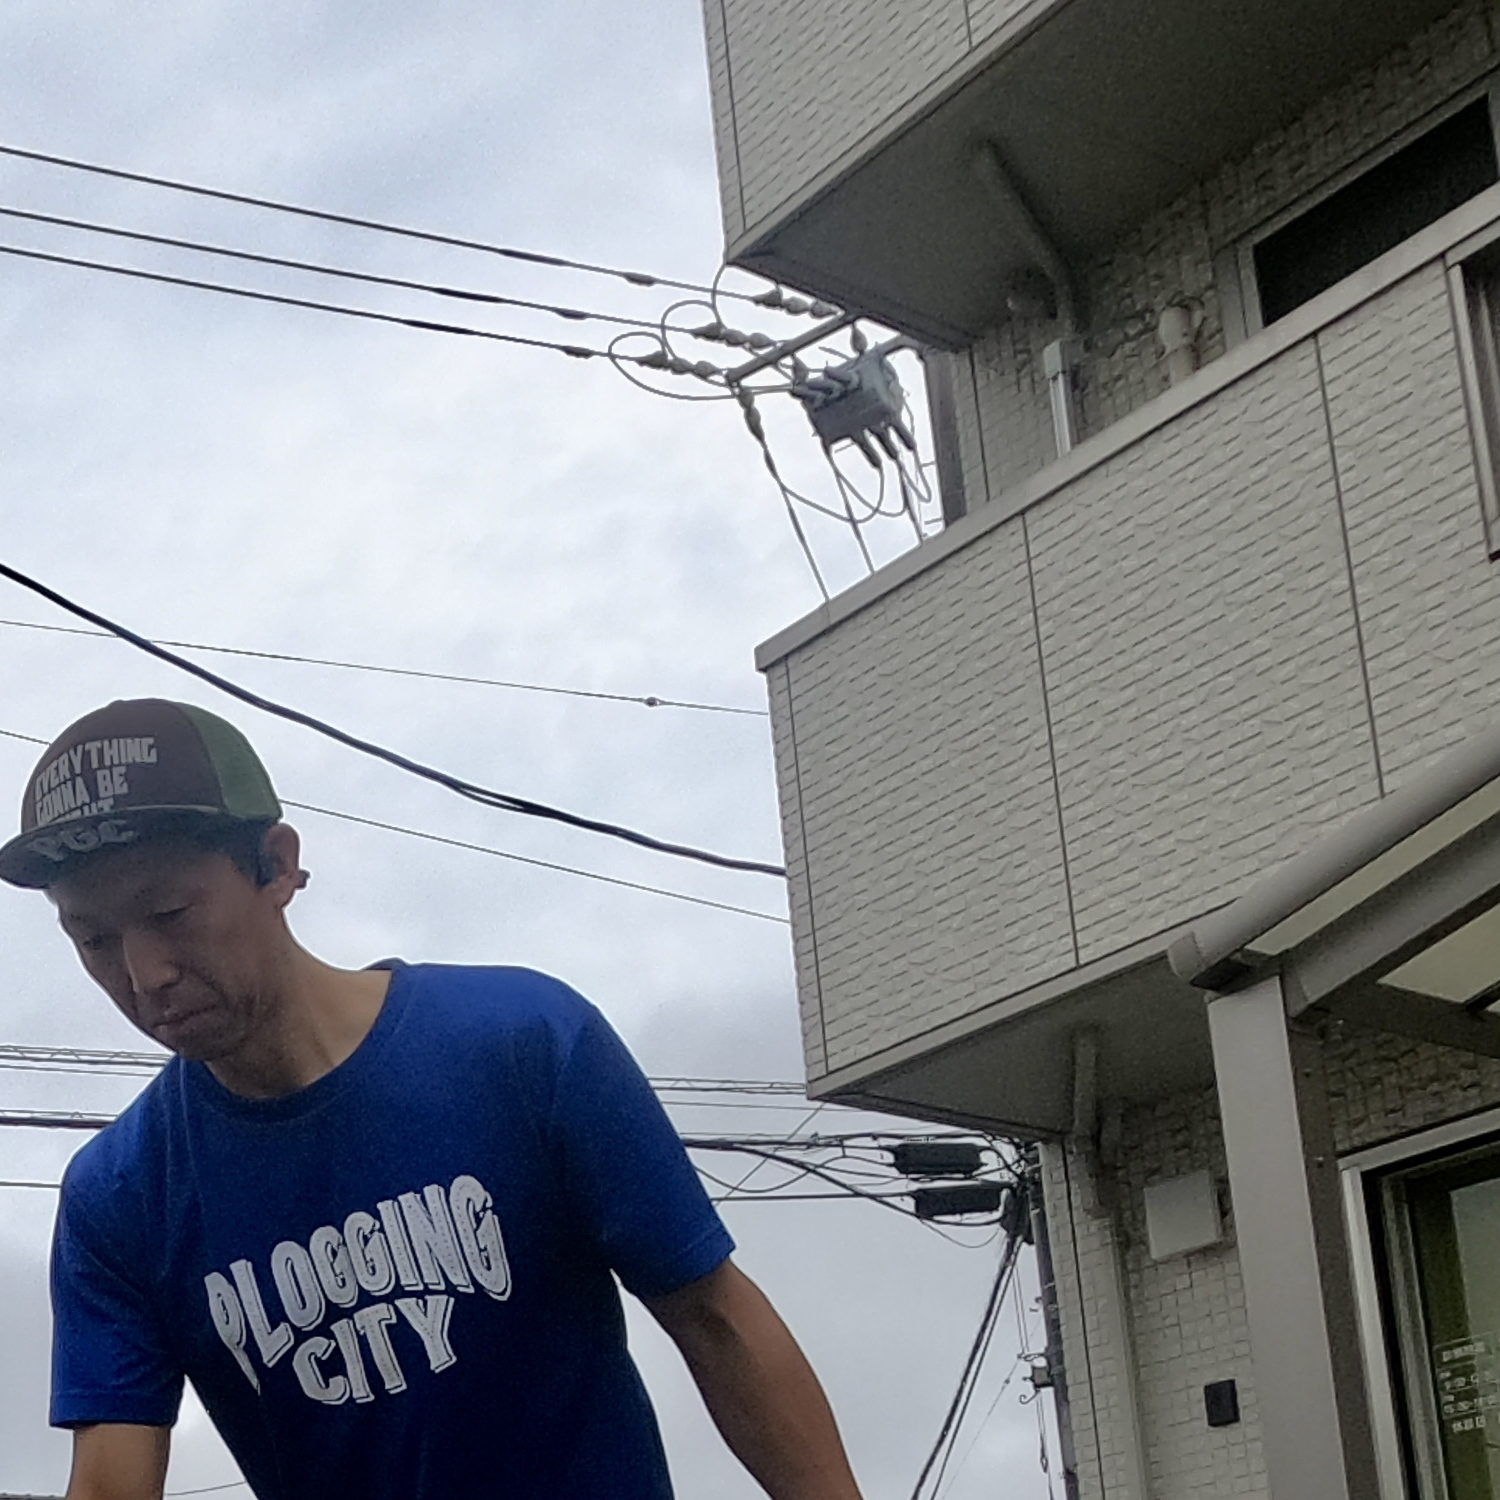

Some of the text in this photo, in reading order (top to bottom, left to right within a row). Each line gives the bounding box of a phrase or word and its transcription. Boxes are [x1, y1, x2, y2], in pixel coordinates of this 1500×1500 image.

[35, 737, 157, 801] EVERYTHING
[35, 776, 91, 827] GONNA
[96, 766, 129, 798] BE
[204, 1175, 512, 1396] PLOGGING
[292, 1295, 457, 1405] CITY
